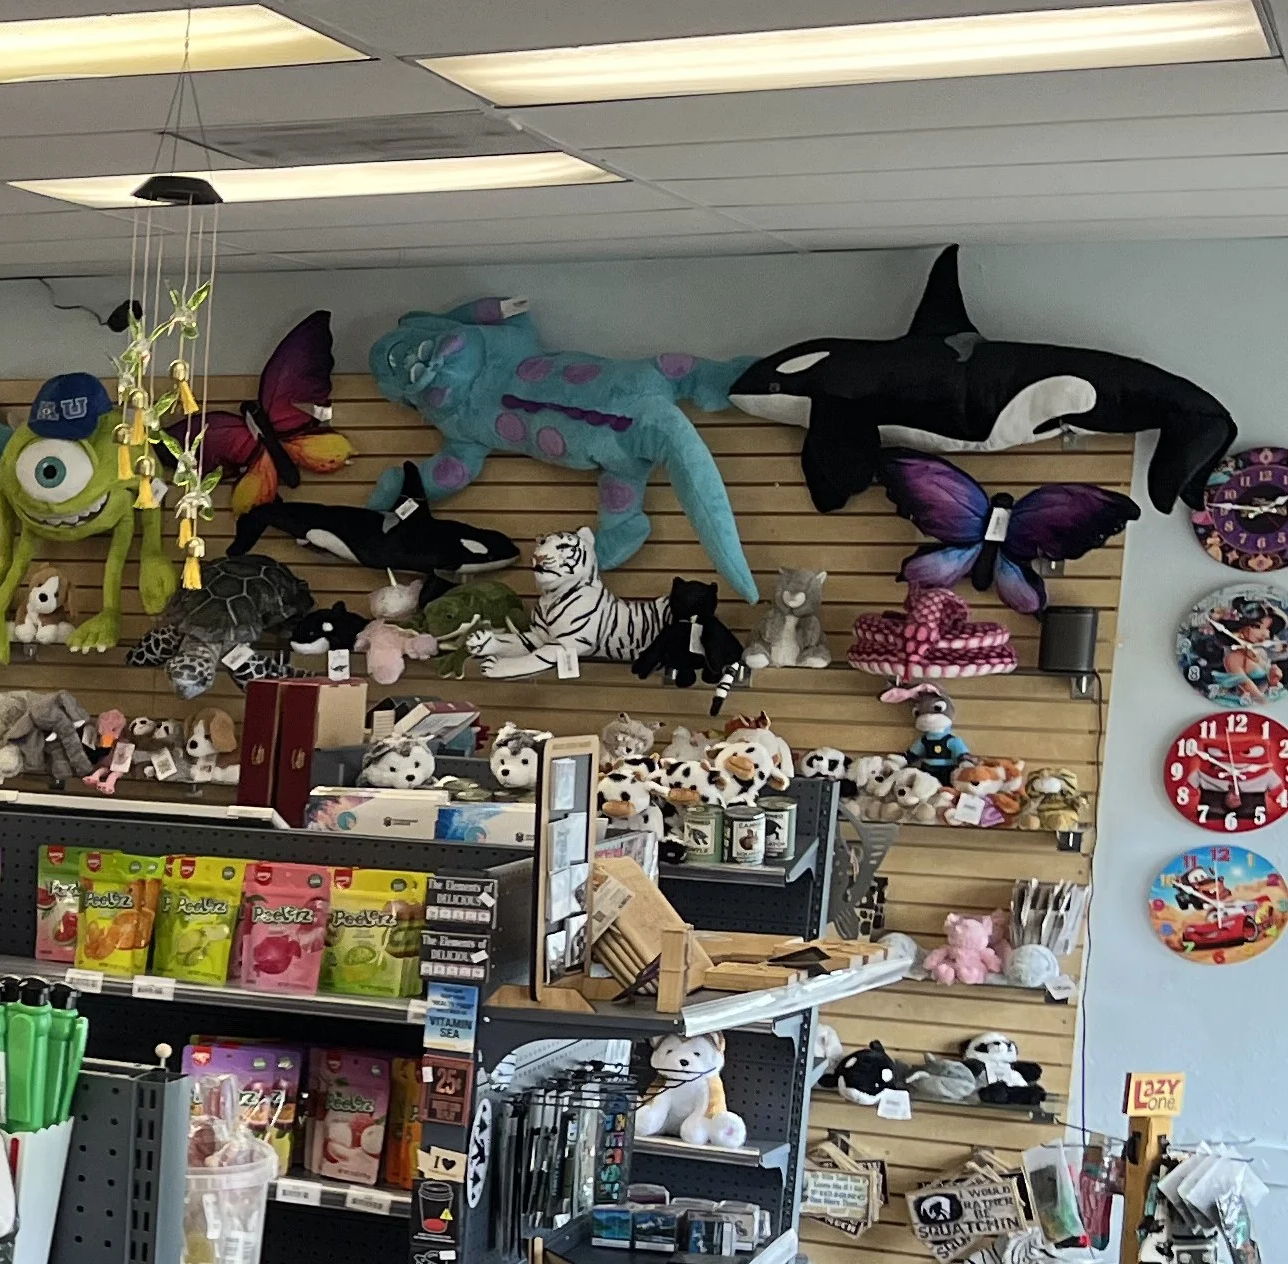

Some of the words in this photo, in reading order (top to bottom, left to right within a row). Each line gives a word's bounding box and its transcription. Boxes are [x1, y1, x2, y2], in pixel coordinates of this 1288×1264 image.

[1199, 721, 1217, 739] 11
[1227, 714, 1248, 732] 12
[1178, 738, 1198, 756] 10
[428, 878, 442, 891] The
[445, 880, 481, 893] Elements
[483, 881, 494, 893] of
[436, 893, 481, 905] DELICIOU
[429, 1016, 473, 1030] VITAMIN
[439, 1027, 460, 1039] SEA
[433, 1155, 441, 1169] I
[964, 1198, 1013, 1209] RATHER
[974, 1208, 989, 1220] BE
[918, 1217, 1021, 1239] SQUATCHIN
